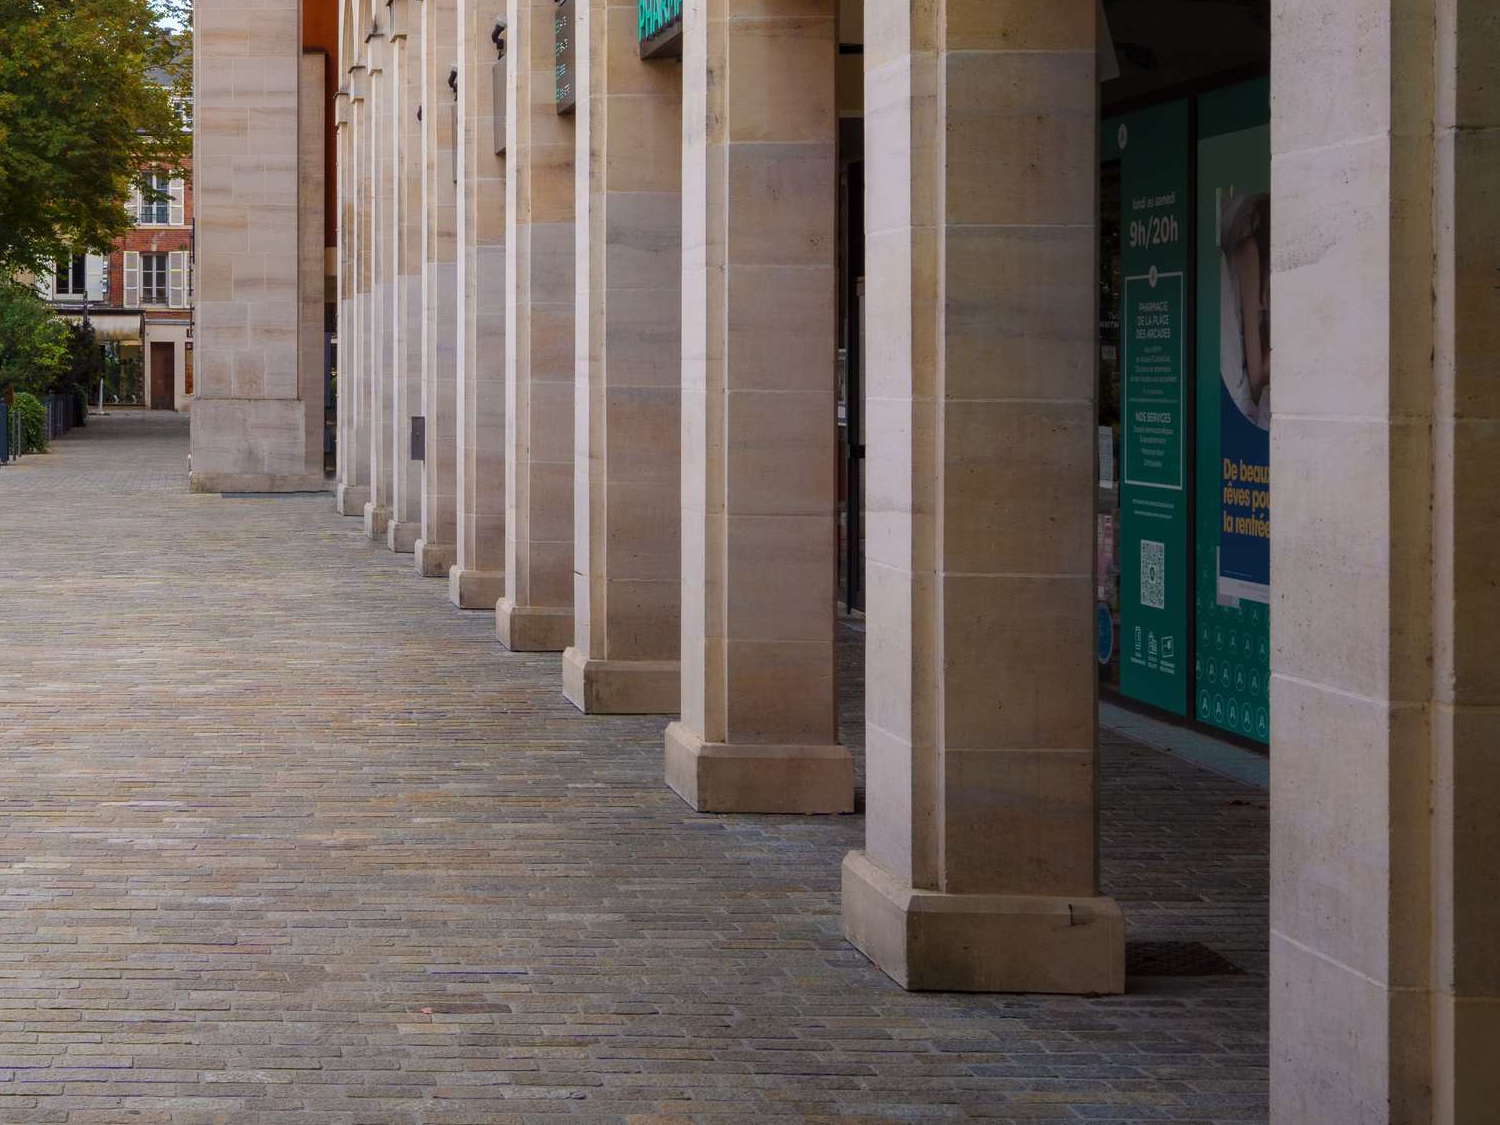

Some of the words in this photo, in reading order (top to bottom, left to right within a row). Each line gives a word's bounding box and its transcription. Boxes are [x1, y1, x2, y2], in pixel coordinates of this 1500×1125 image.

[1129, 214, 1178, 250] 9h/20h
[1223, 458, 1238, 480] De
[1223, 481, 1251, 507] rêves
[1223, 510, 1234, 533] la
